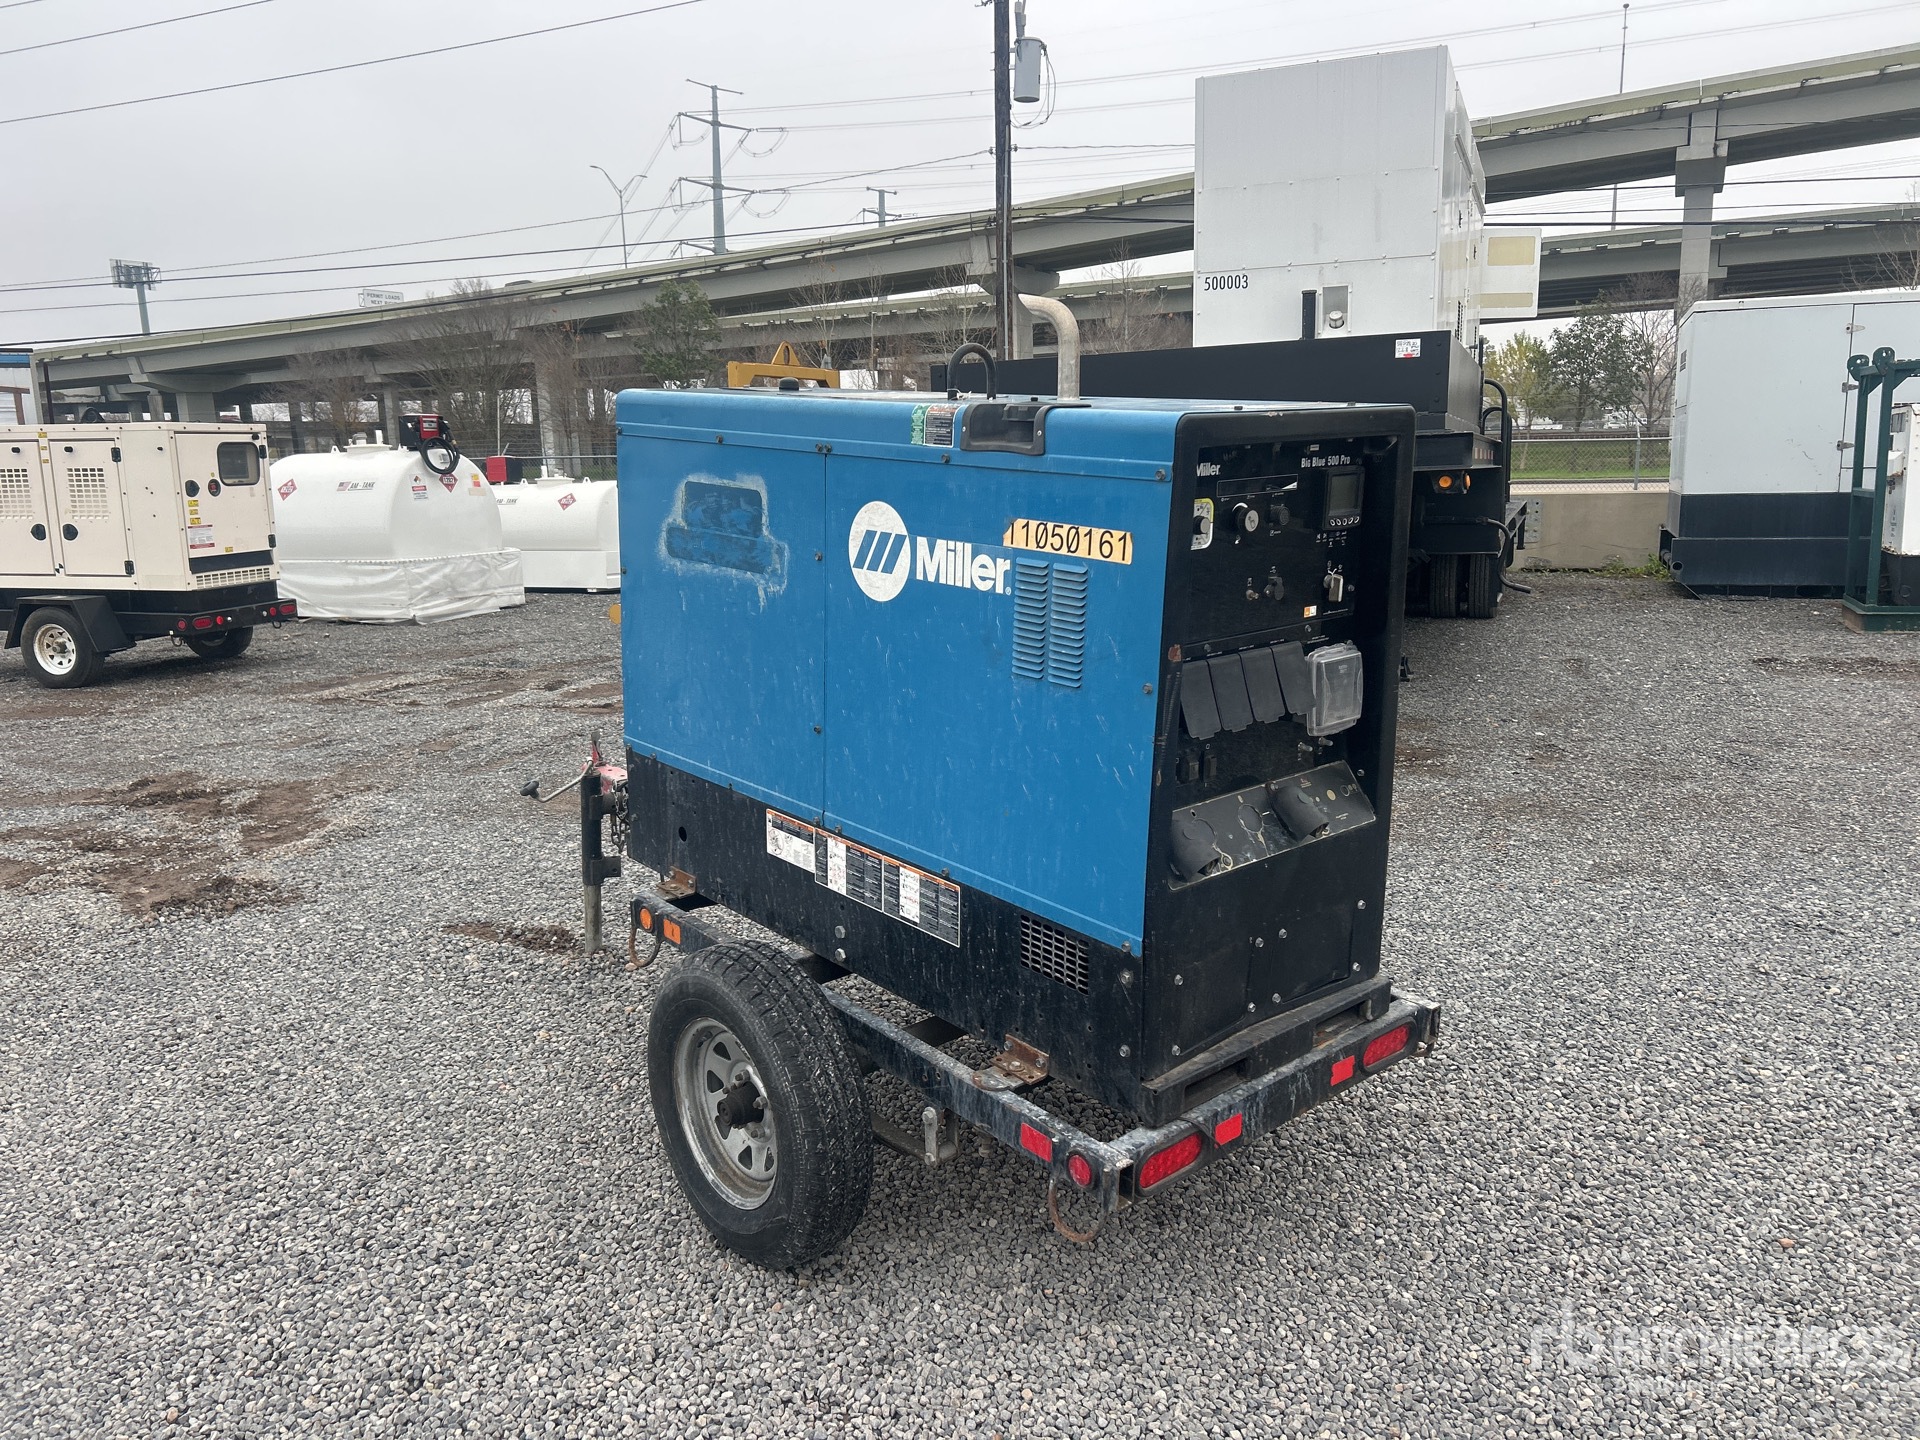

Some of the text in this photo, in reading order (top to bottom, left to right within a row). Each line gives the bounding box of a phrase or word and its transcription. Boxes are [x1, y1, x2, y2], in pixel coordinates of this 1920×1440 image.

[1204, 275, 1249, 291] 500003
[1301, 454, 1351, 468] Big Blue 500 Pro
[916, 536, 1011, 594] Miller
